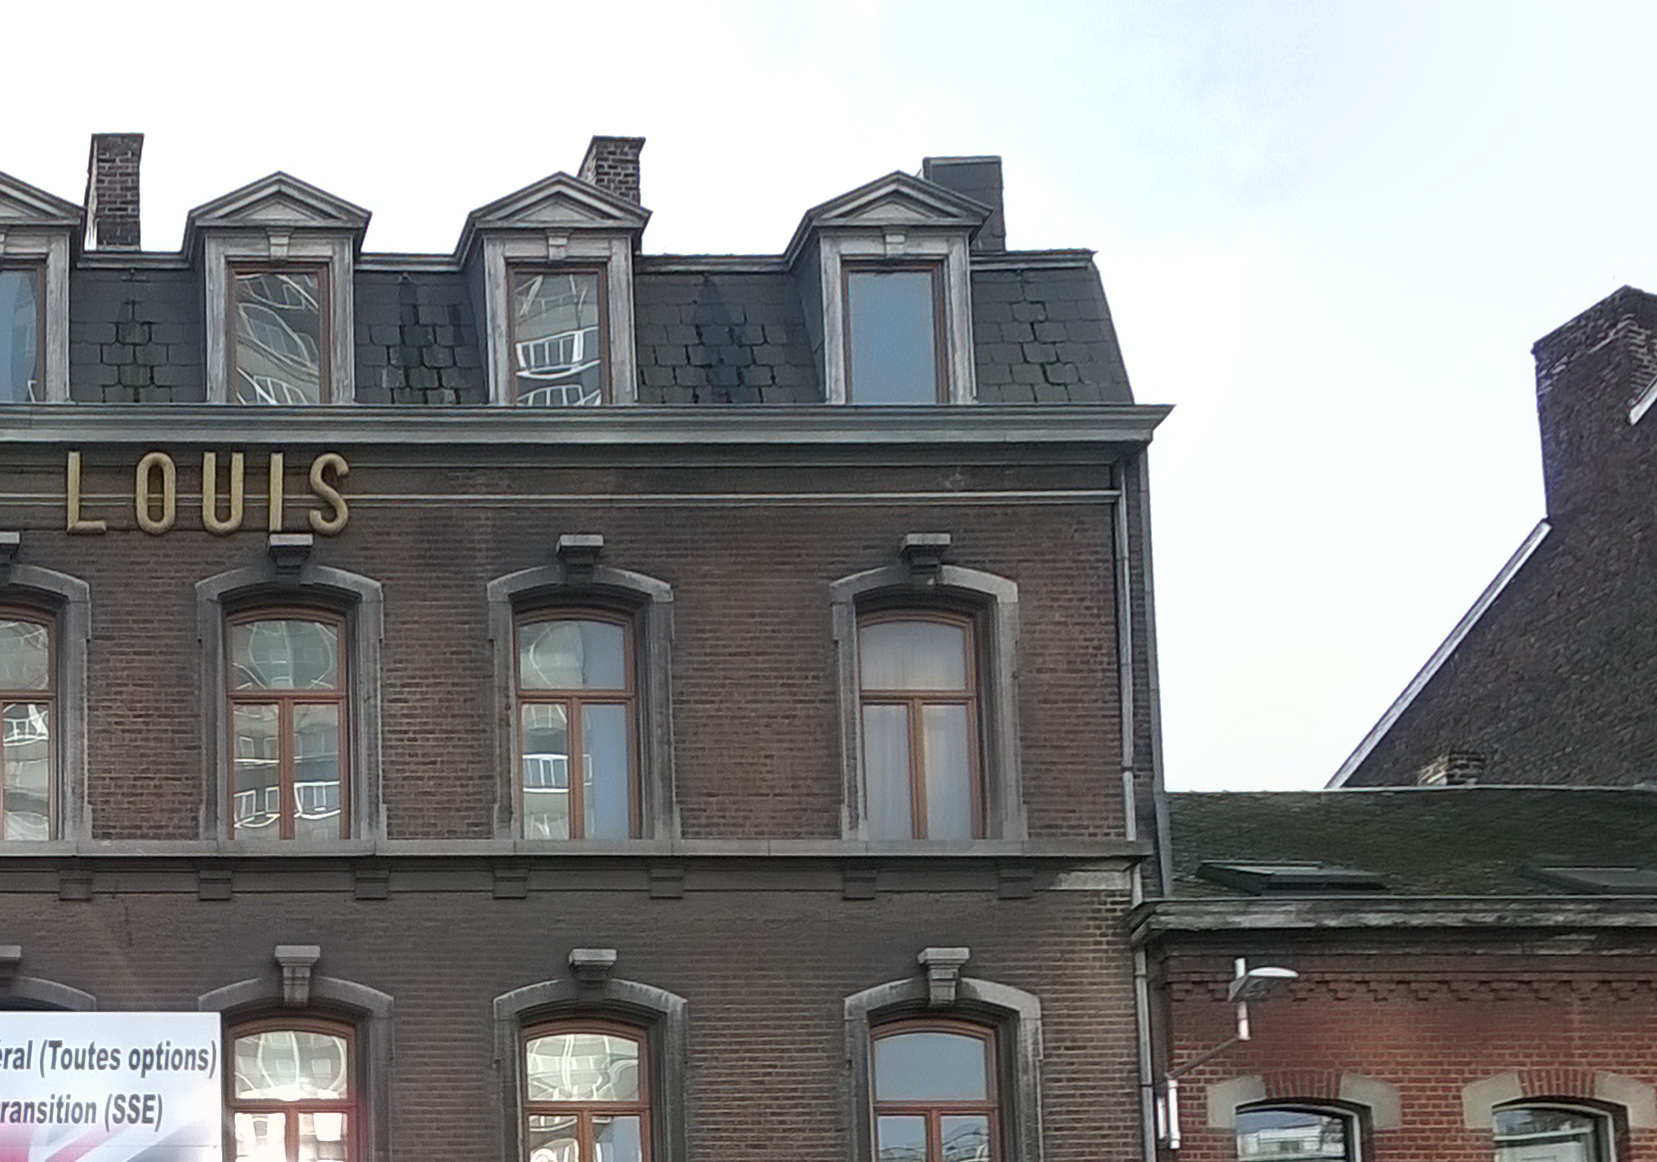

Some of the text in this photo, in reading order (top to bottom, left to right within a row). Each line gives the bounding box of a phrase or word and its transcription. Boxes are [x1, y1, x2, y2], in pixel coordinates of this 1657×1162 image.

[66, 450, 349, 535] LOUIS
[40, 1040, 122, 1077] (Toutes
[127, 1040, 218, 1078] options)
[104, 1093, 164, 1132] (SSE)
